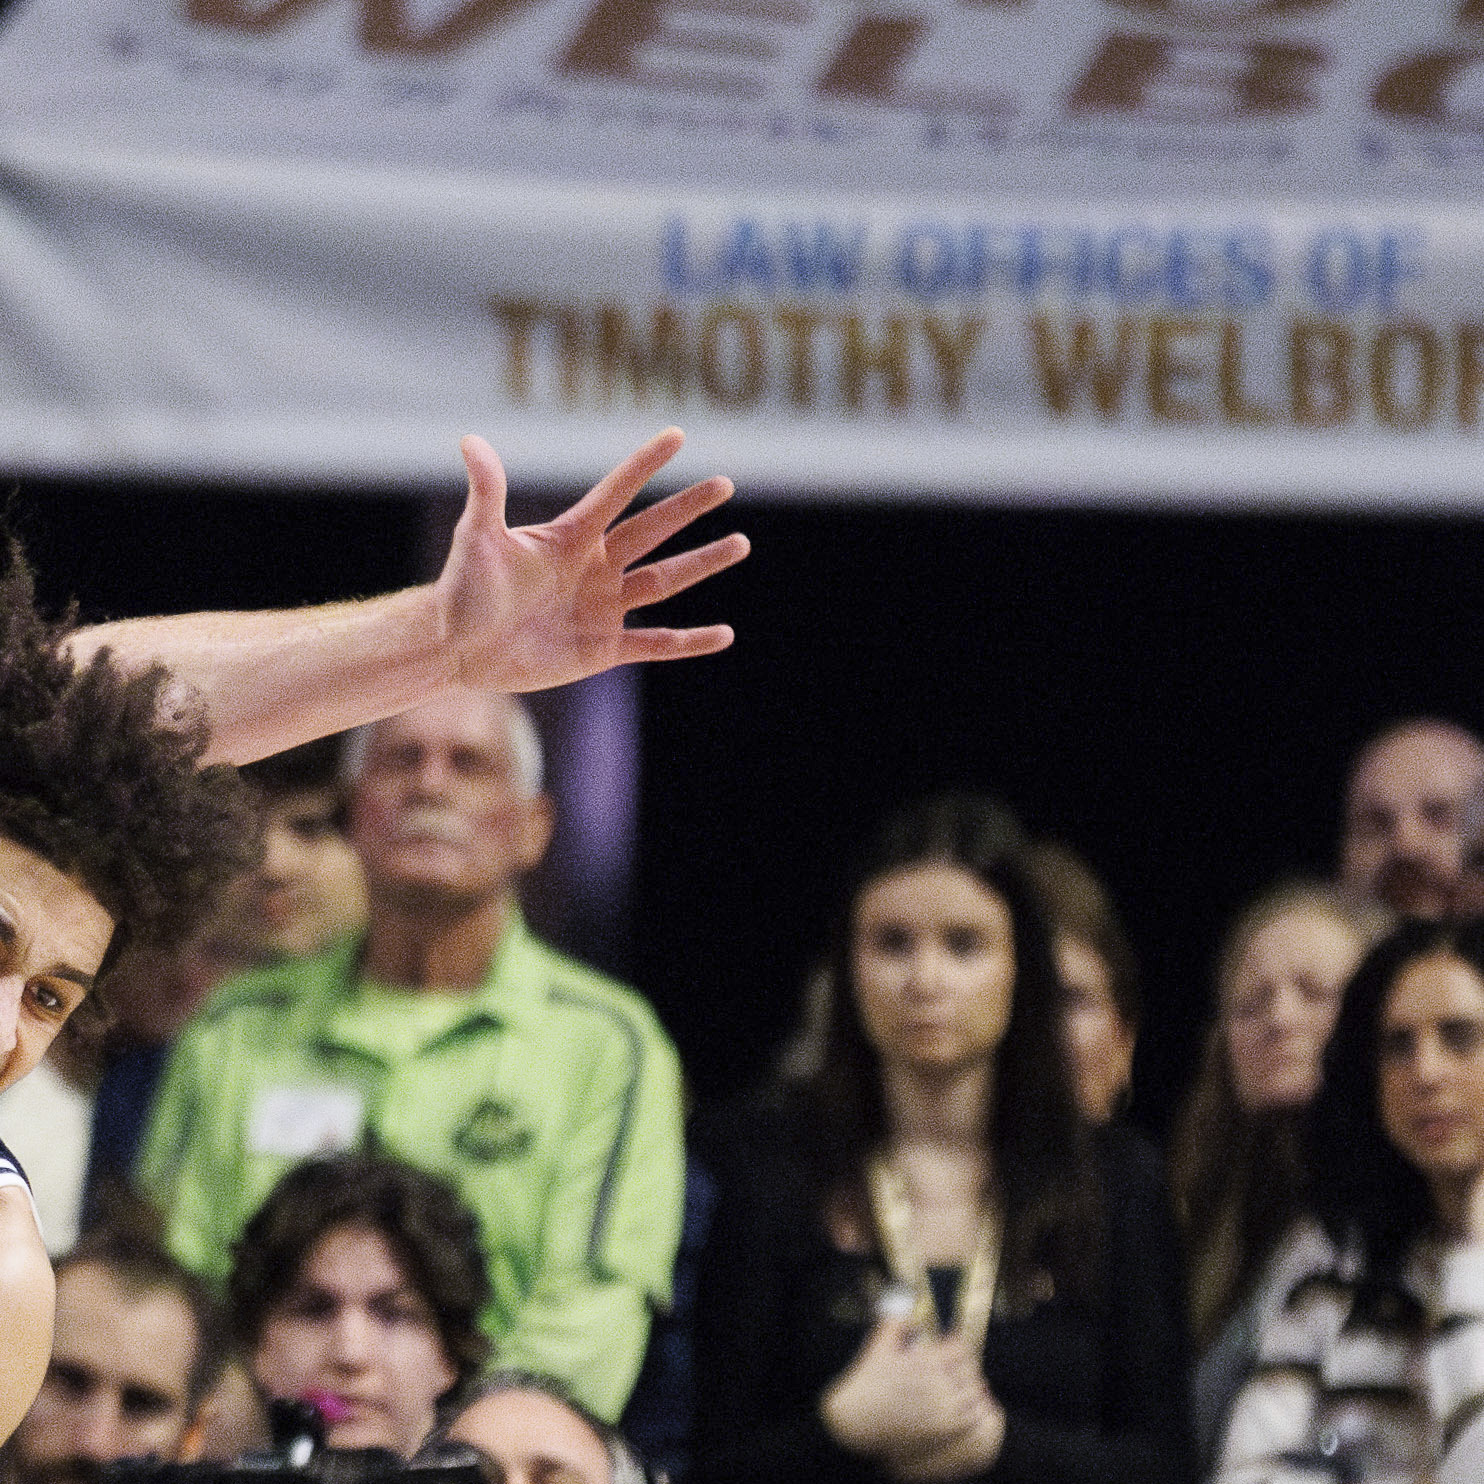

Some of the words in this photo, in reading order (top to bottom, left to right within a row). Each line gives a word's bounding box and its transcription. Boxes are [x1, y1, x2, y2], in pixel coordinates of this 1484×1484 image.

[660, 215, 866, 296] LAW
[896, 220, 1277, 308] OFFICES
[1305, 226, 1424, 310] OF
[487, 296, 987, 414] TIMOTHY
